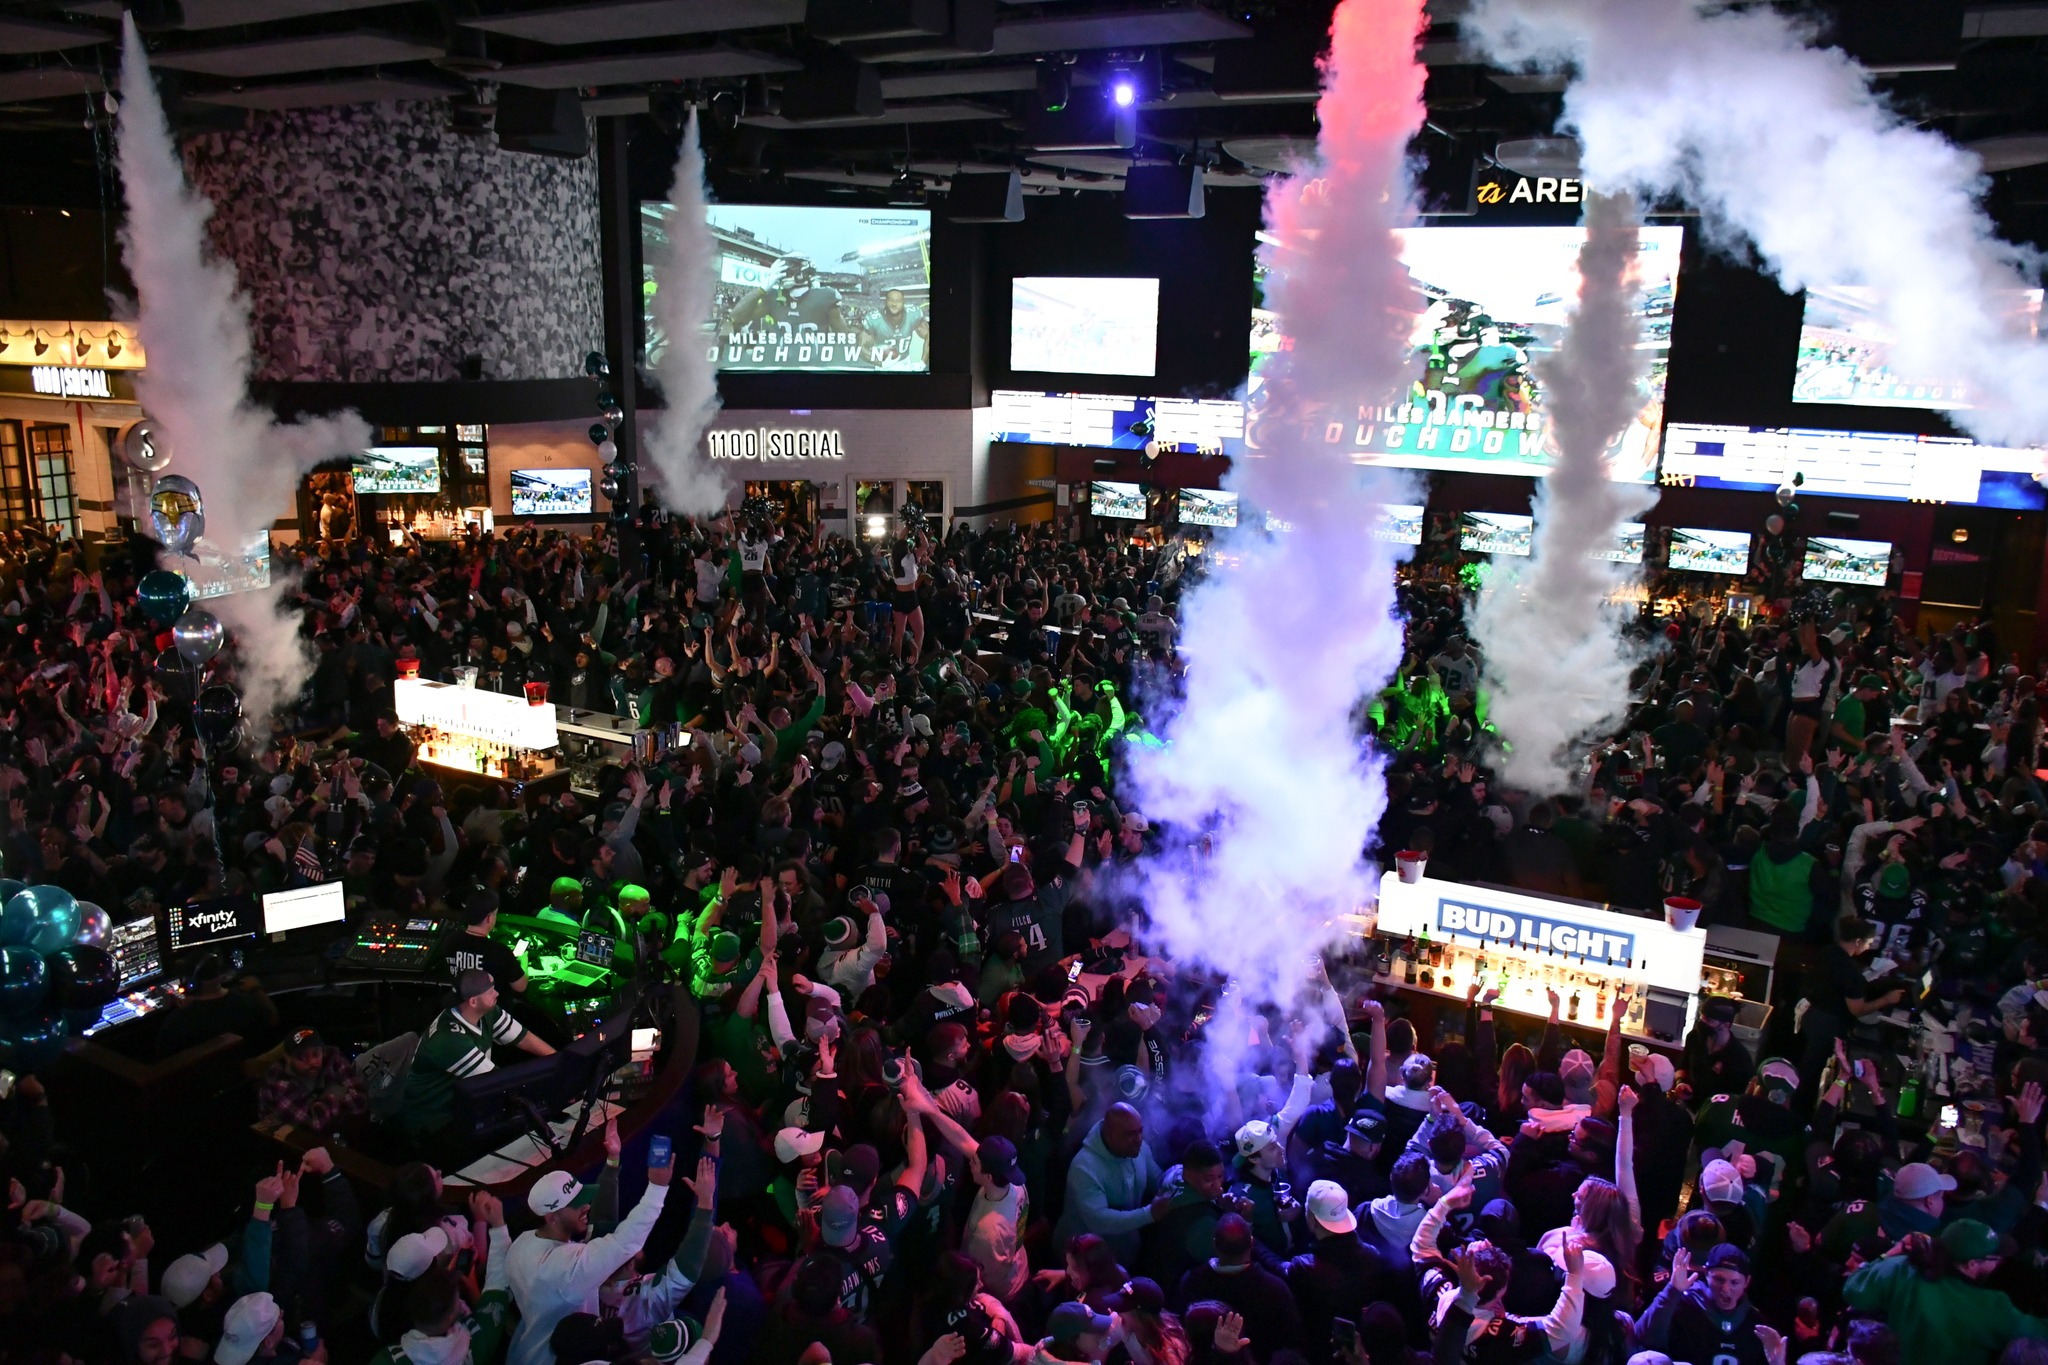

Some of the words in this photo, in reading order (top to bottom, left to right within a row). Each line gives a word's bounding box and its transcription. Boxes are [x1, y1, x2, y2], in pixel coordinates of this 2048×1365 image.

[728, 332, 778, 345] MILES
[783, 332, 857, 345] SANDERS
[705, 346, 885, 363] OUCHDOWN
[1357, 405, 1424, 425] MILES
[1431, 408, 1541, 431] SANDERS
[709, 430, 757, 459] 1100
[768, 430, 845, 459] SOCIAL
[1301, 421, 1549, 457] TOUCHDOW
[865, 876, 892, 888] SMITH
[188, 909, 235, 928] xfinity
[1442, 903, 1516, 939] BUD
[456, 952, 484, 971] RIDE
